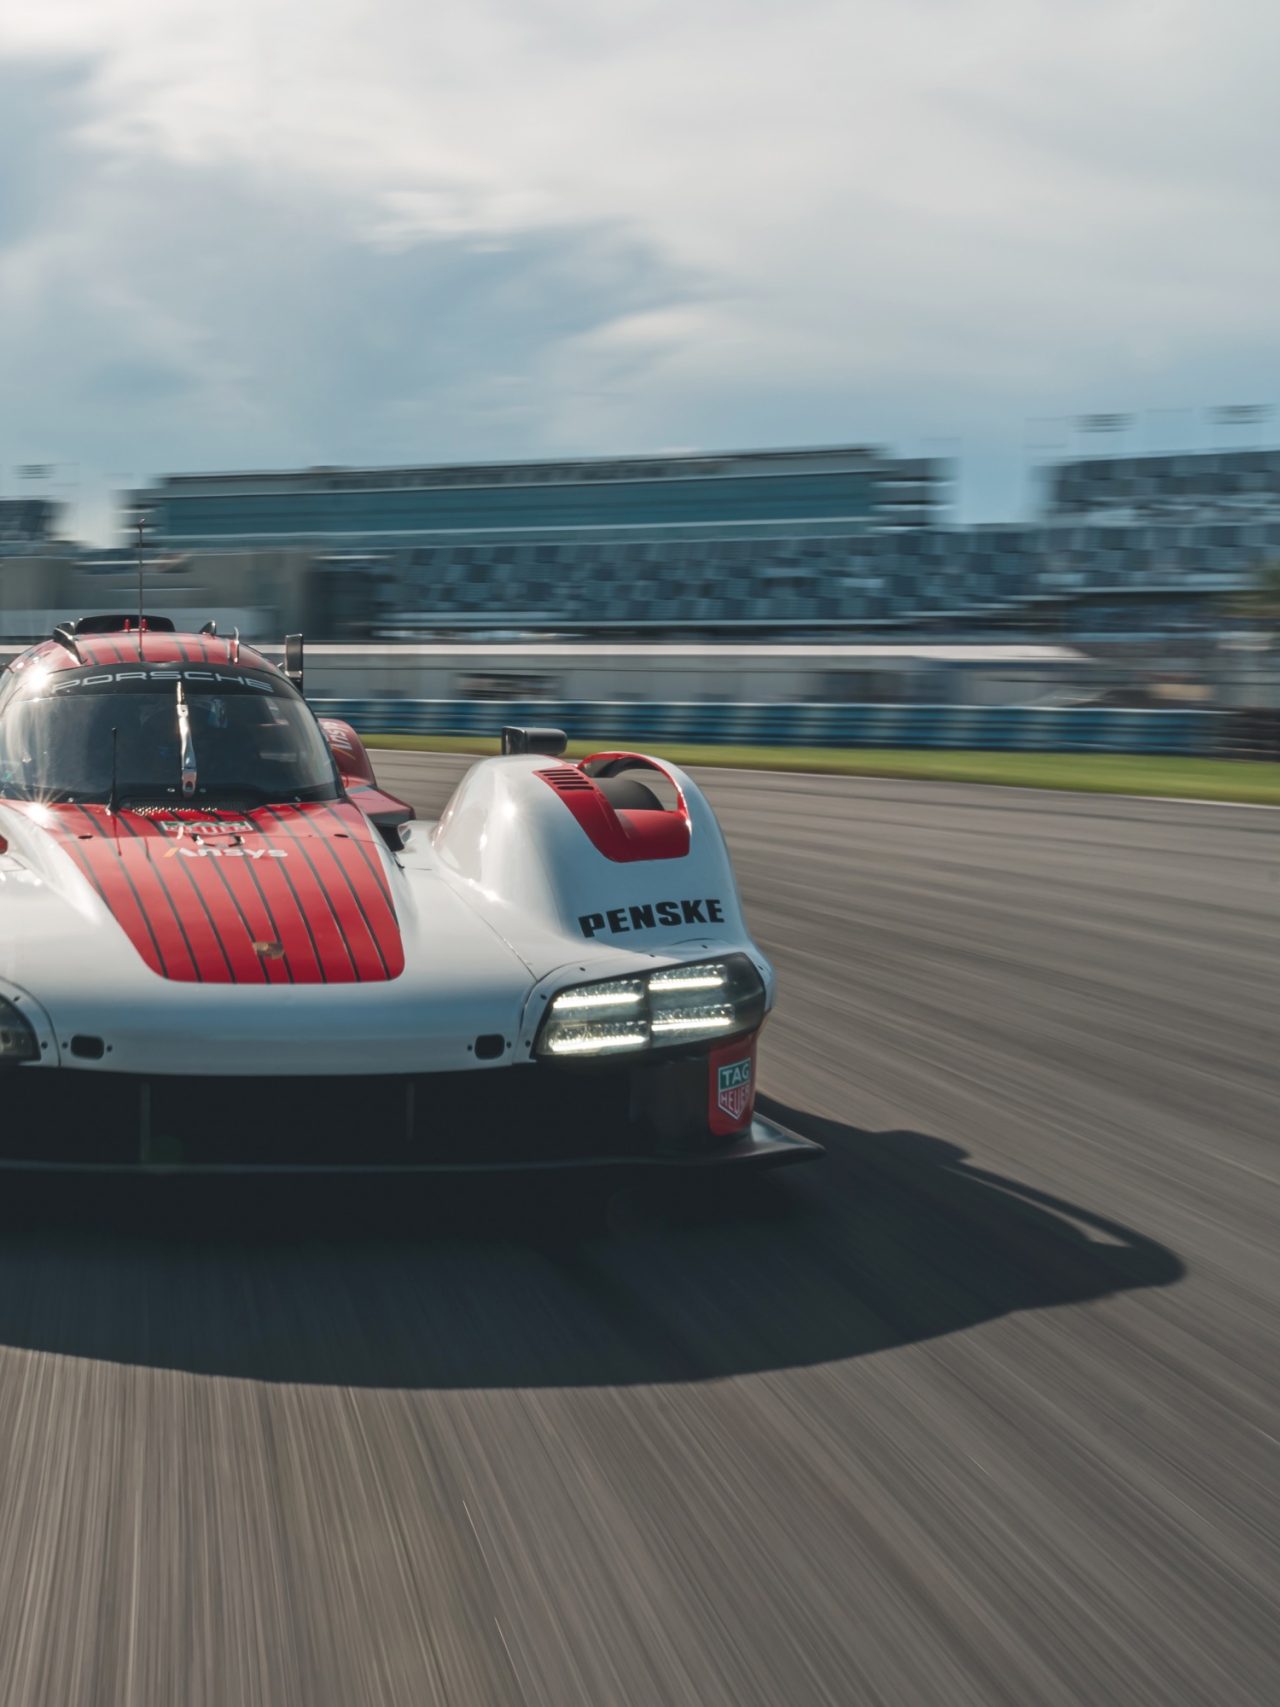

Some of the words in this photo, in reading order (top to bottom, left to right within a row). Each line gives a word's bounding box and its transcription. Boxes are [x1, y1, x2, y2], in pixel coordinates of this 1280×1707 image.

[51, 671, 275, 694] PORSCHE
[163, 847, 288, 859] Ansys
[578, 899, 725, 938] PENSKE
[722, 1063, 749, 1086] TAG
